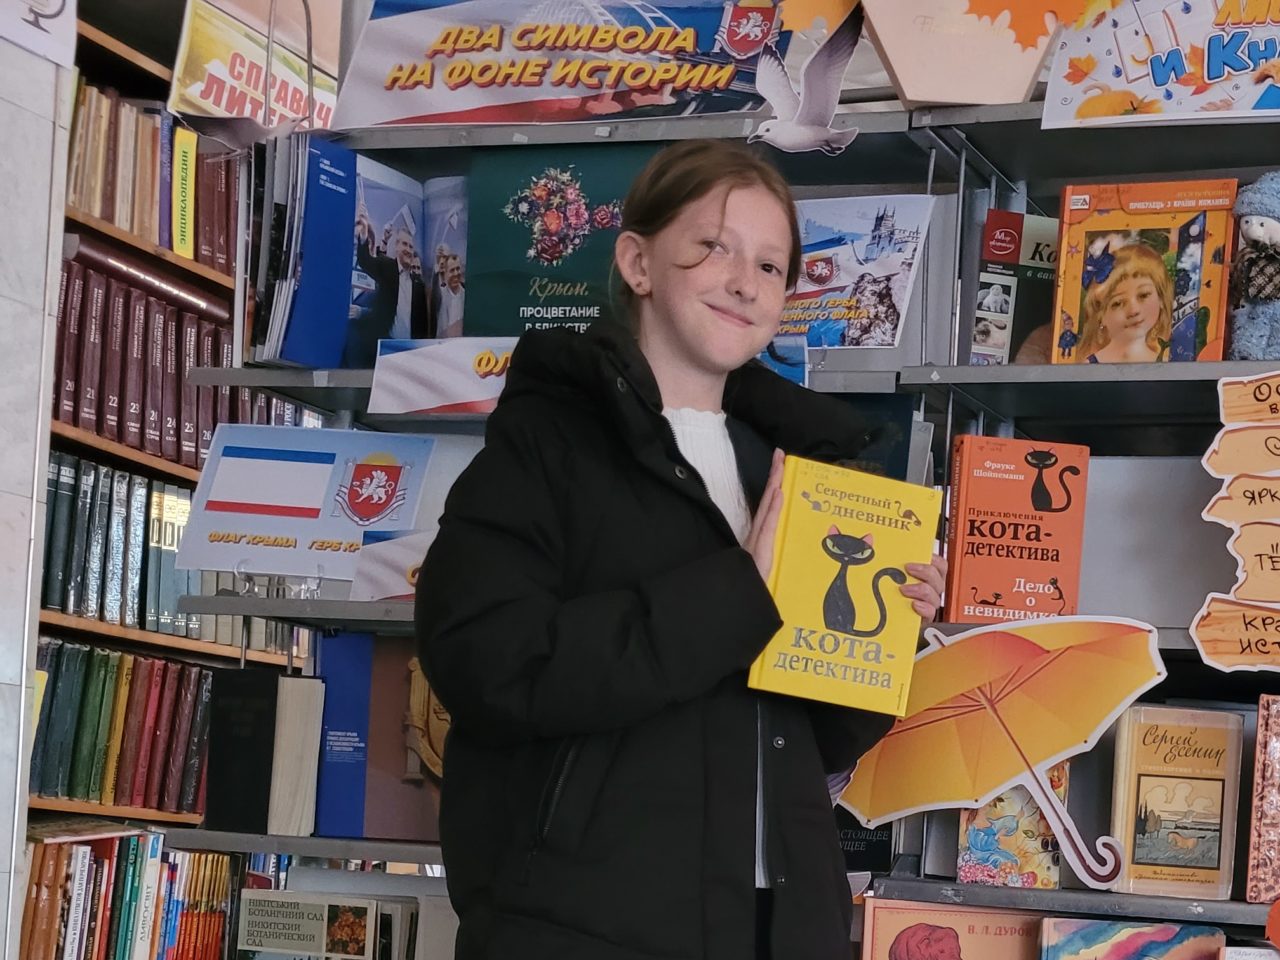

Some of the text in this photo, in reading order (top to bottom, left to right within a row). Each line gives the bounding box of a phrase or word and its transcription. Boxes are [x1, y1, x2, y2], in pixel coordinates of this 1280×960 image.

[426, 23, 698, 58] ДВА СИМВОЛА
[384, 57, 736, 92] НА ФОНЕ ИСТОРИИ
[1149, 47, 1188, 87] И
[520, 307, 600, 318] ПРОЦВЕТАНИЕ
[86, 388, 95, 399] 21
[108, 396, 118, 407] 22
[130, 402, 140, 414] 23
[166, 417, 176, 428] 24
[184, 422, 194, 433] 25
[202, 430, 212, 441] 26
[815, 482, 892, 510] Секретный
[833, 505, 912, 532] дневник
[968, 508, 1044, 521] Приключения
[246, 535, 298, 549] КРЫМА
[307, 540, 342, 552] ГЕРБ
[965, 541, 1060, 563] детектива
[1013, 578, 1055, 594] Дело
[774, 652, 893, 689] детектива
